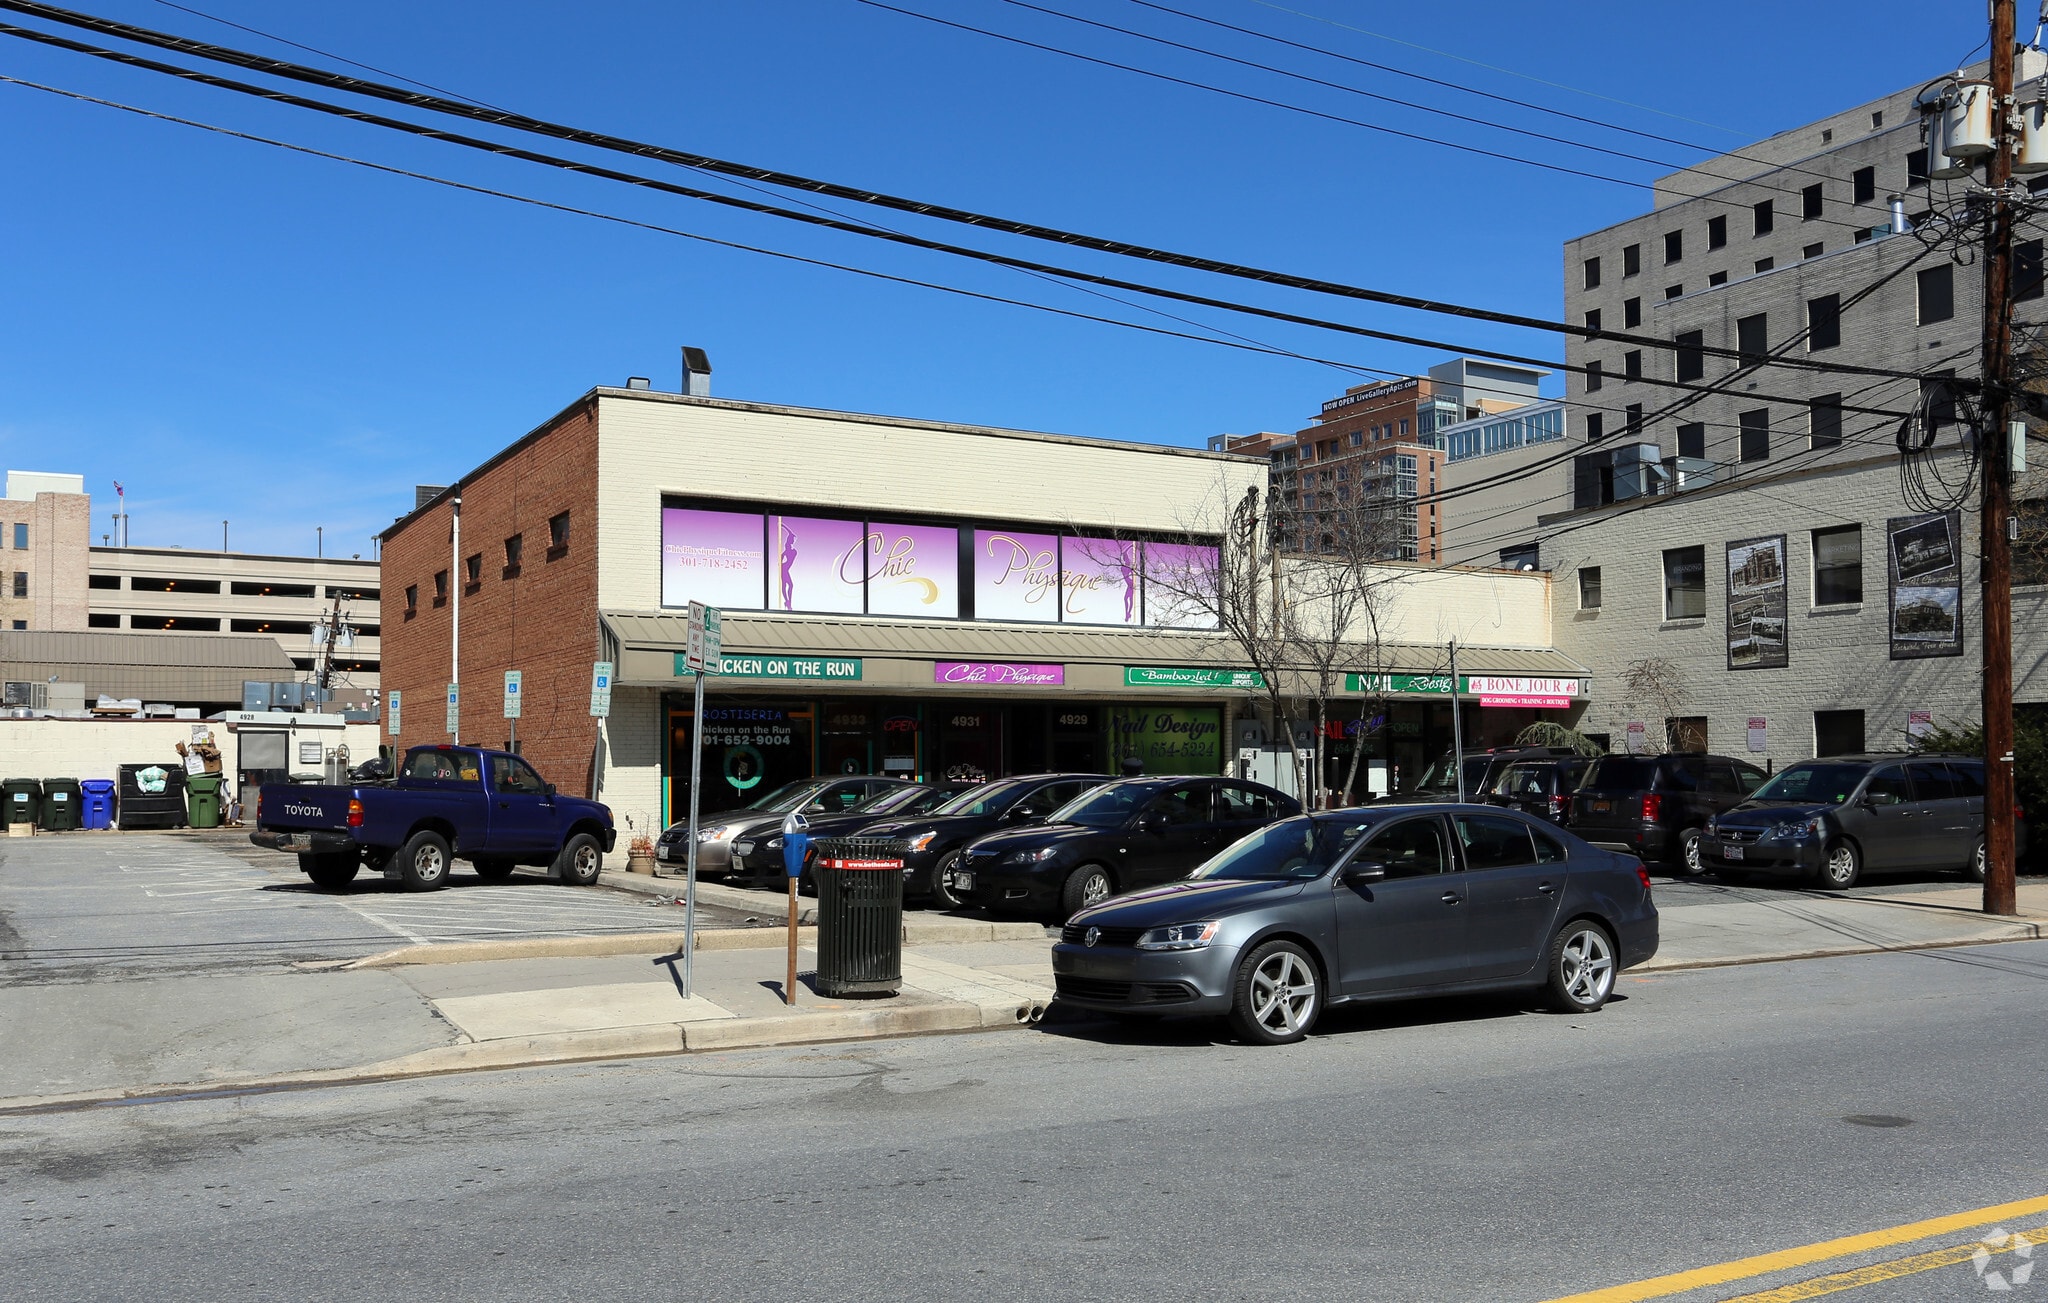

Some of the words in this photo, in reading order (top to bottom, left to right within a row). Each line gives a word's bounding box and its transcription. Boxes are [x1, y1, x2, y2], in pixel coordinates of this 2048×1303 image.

[1323, 401, 1338, 411] NOW
[1338, 396, 1354, 407] OPEN
[1356, 380, 1417, 402] LiveGalleryApts.com
[680, 557, 748, 570] 301-718-2452
[840, 532, 916, 584] Chic
[987, 534, 1102, 613] Physique
[693, 607, 701, 620] NO
[719, 659, 761, 674] ICKEN
[767, 660, 788, 674] ON
[793, 661, 821, 675] THE
[826, 662, 855, 676] RUN
[944, 664, 987, 682] Chic
[991, 664, 1055, 684] Physique
[1358, 674, 1405, 692] NAIL
[1487, 677, 1523, 692] BONE
[1526, 678, 1561, 693] JOUR
[1546, 698, 1568, 706] BOUTIQUE
[240, 713, 255, 721] 4928
[833, 714, 866, 725] 4933
[951, 715, 980, 727] 4931
[1059, 714, 1088, 725] 4929
[703, 725, 737, 734] hicken
[753, 725, 769, 734] the
[772, 725, 791, 734] Run
[884, 720, 918, 732] OPEN
[1103, 713, 1148, 734] Nail
[1154, 712, 1217, 740] Design
[1393, 723, 1419, 733] OPEN
[703, 735, 790, 745] 01-652-9004
[1150, 741, 1214, 758] 654-5224
[284, 804, 323, 818] TOYOTA
